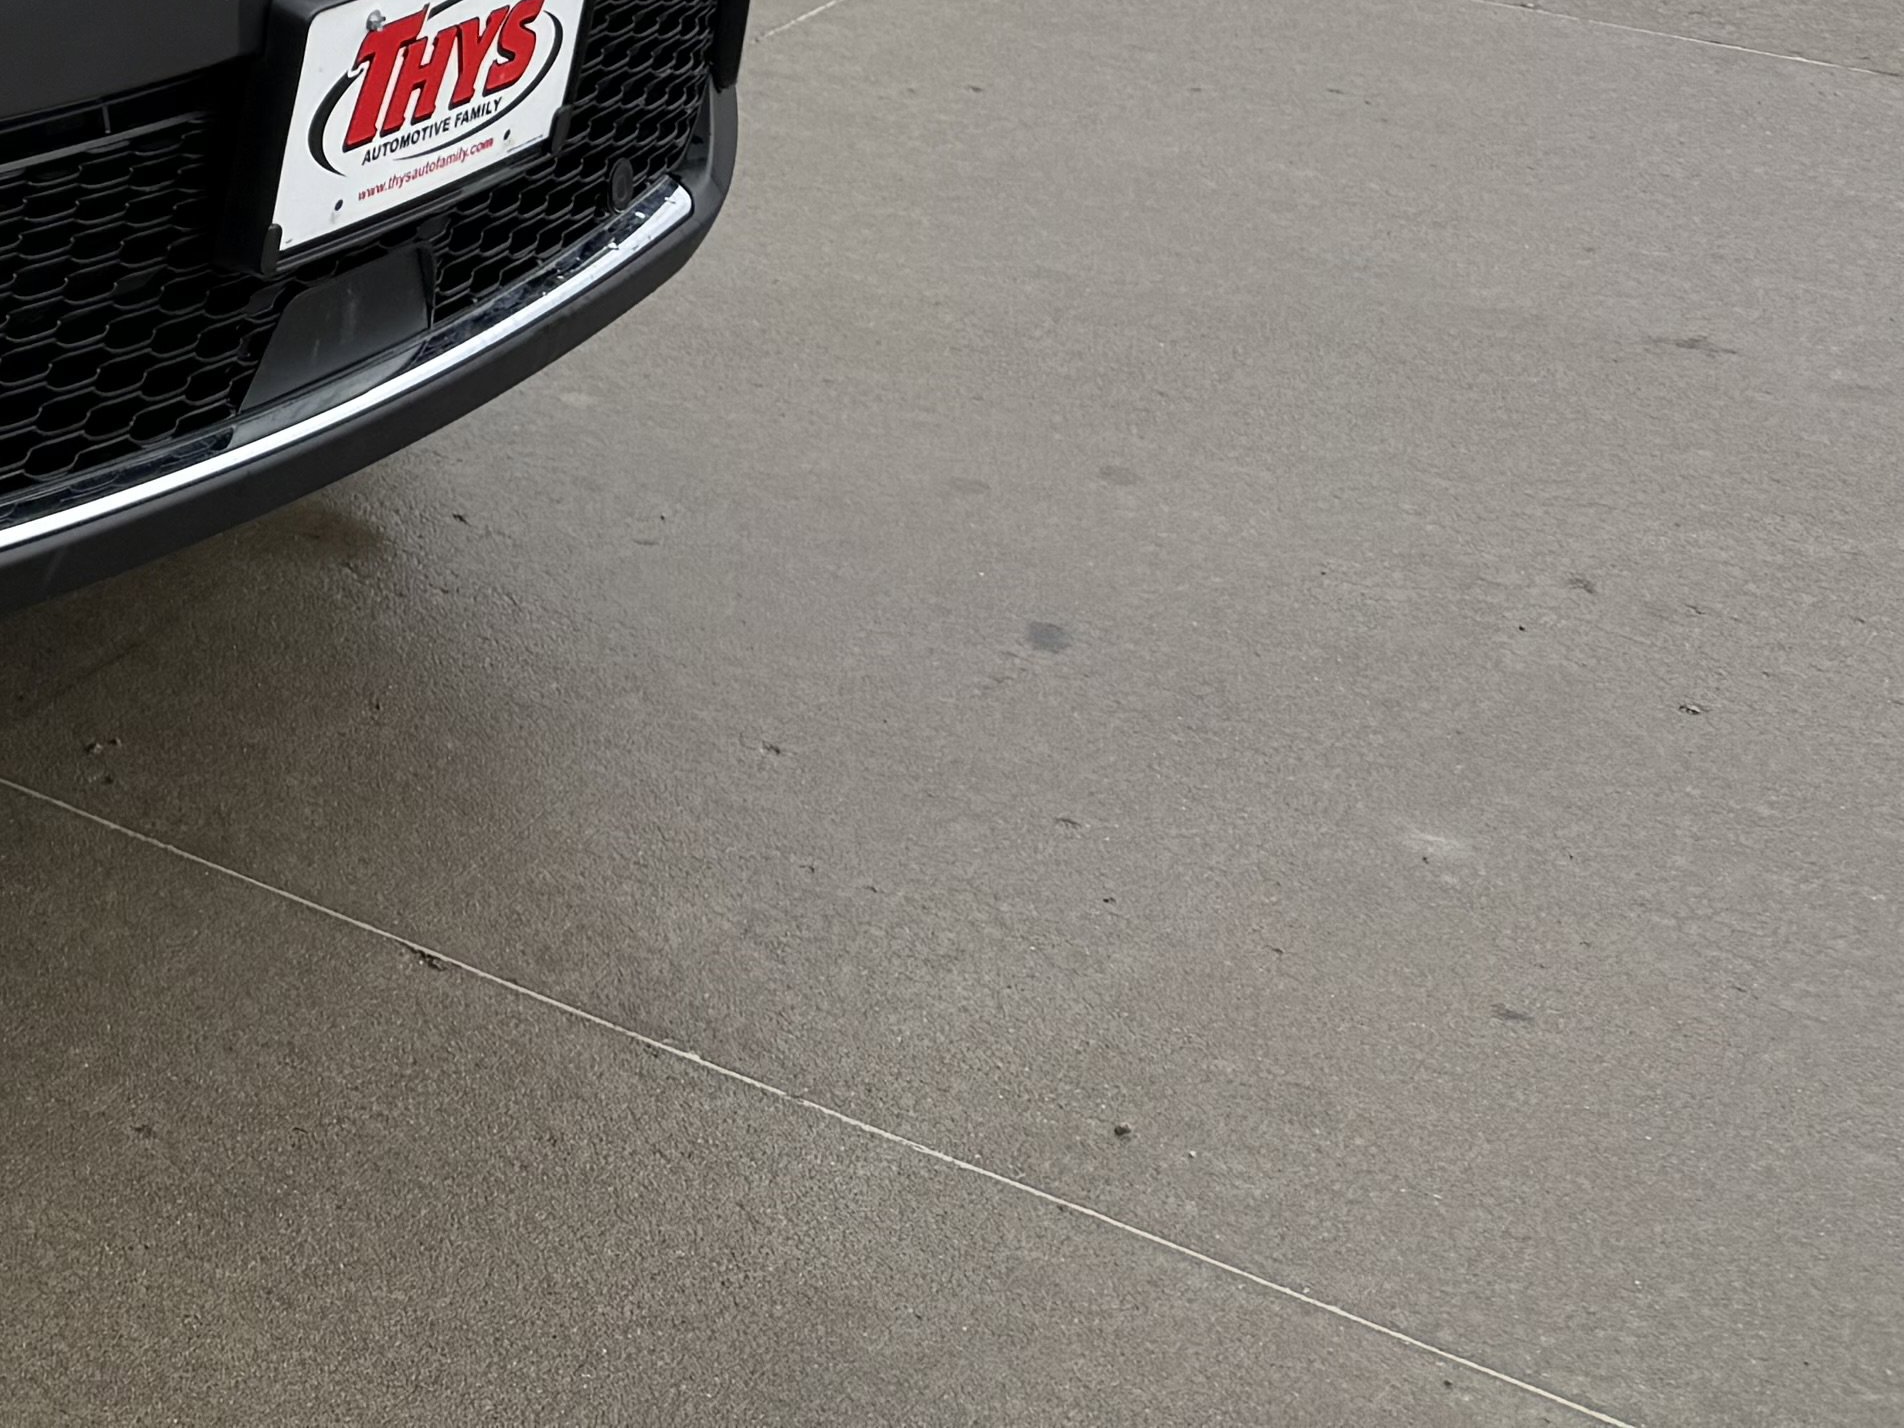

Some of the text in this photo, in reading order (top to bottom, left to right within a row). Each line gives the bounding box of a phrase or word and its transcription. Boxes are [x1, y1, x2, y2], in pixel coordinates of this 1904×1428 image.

[361, 96, 503, 166] AUTOMOTIVE FAMILY
[357, 137, 495, 201] www.thysautofamily.com
